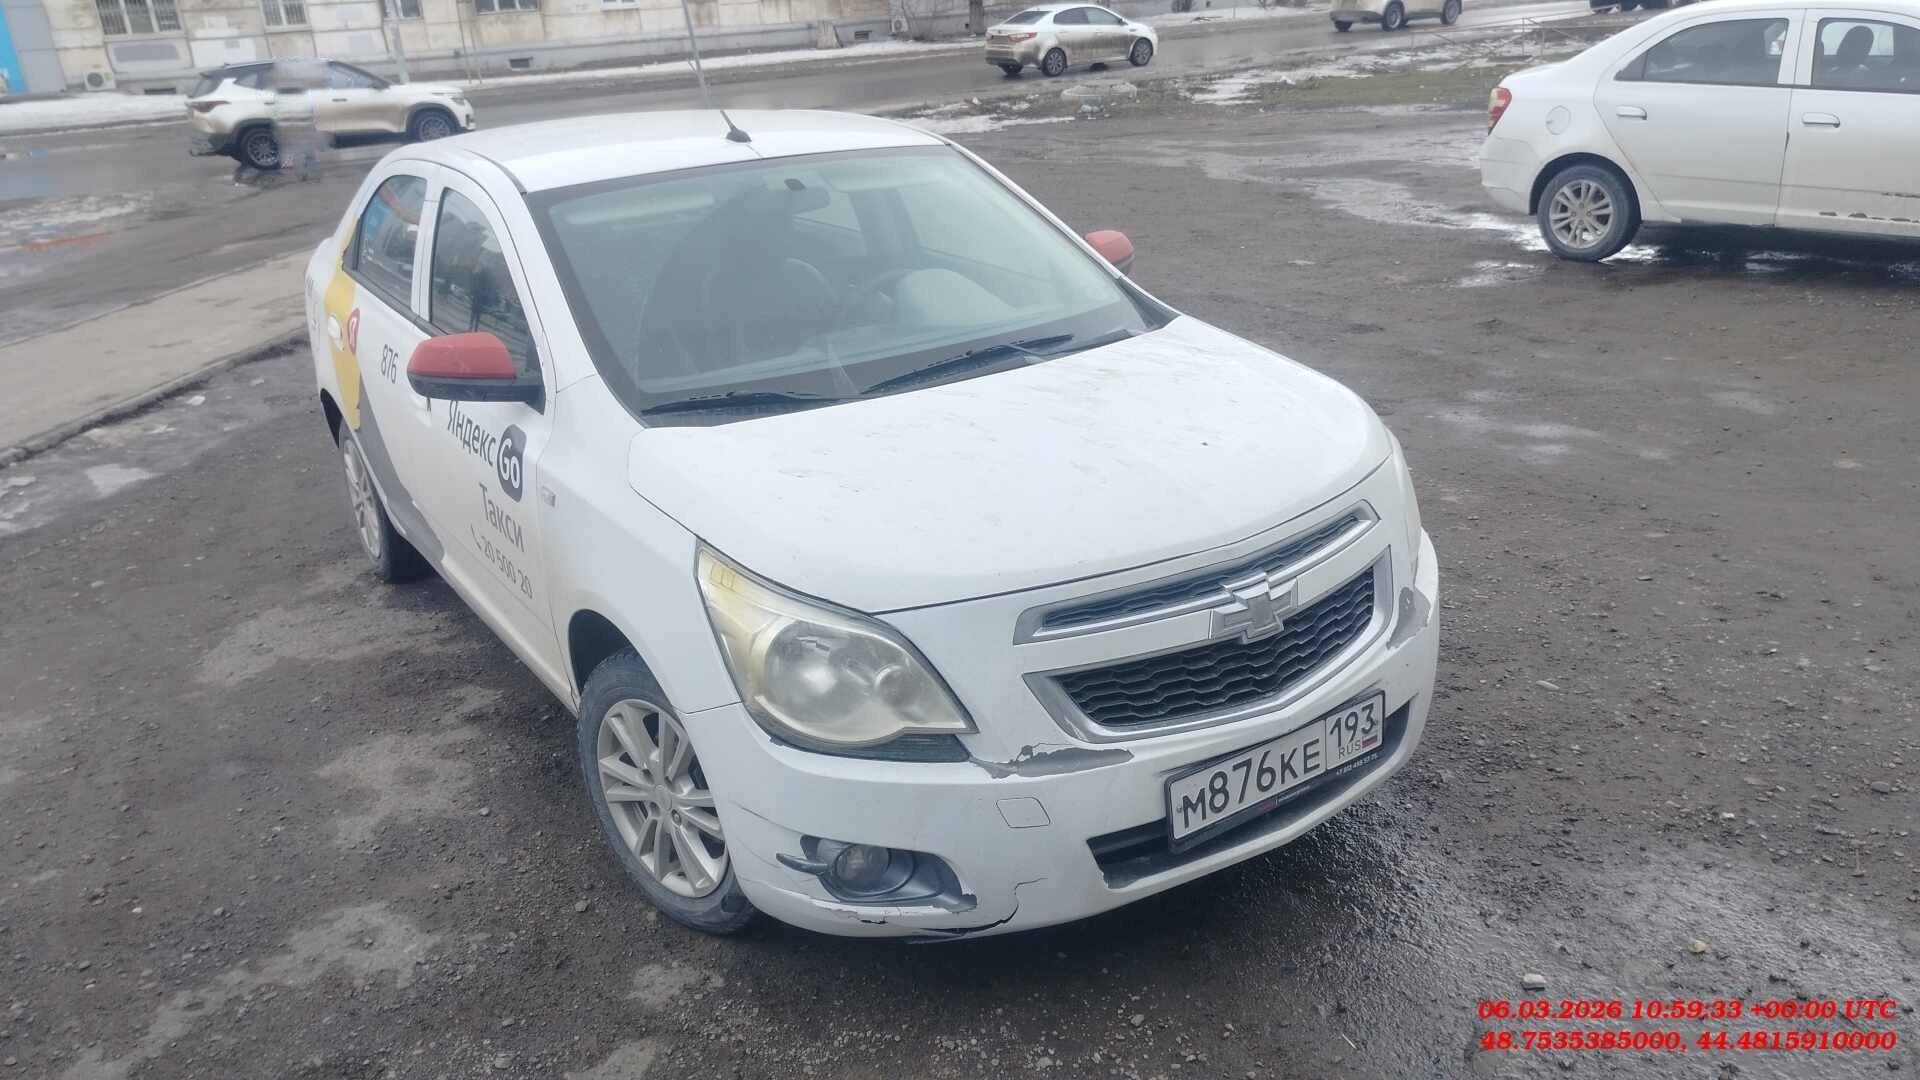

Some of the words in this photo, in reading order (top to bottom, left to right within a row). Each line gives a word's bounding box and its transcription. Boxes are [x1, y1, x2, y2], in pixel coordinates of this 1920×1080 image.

[381, 344, 398, 384] 876
[448, 400, 496, 467] Яндекс
[500, 438, 520, 489] Go
[479, 482, 525, 553] Такси
[481, 535, 496, 564] 20
[518, 570, 534, 599] 20
[1329, 702, 1378, 748] 193
[1338, 741, 1361, 760] RUS
